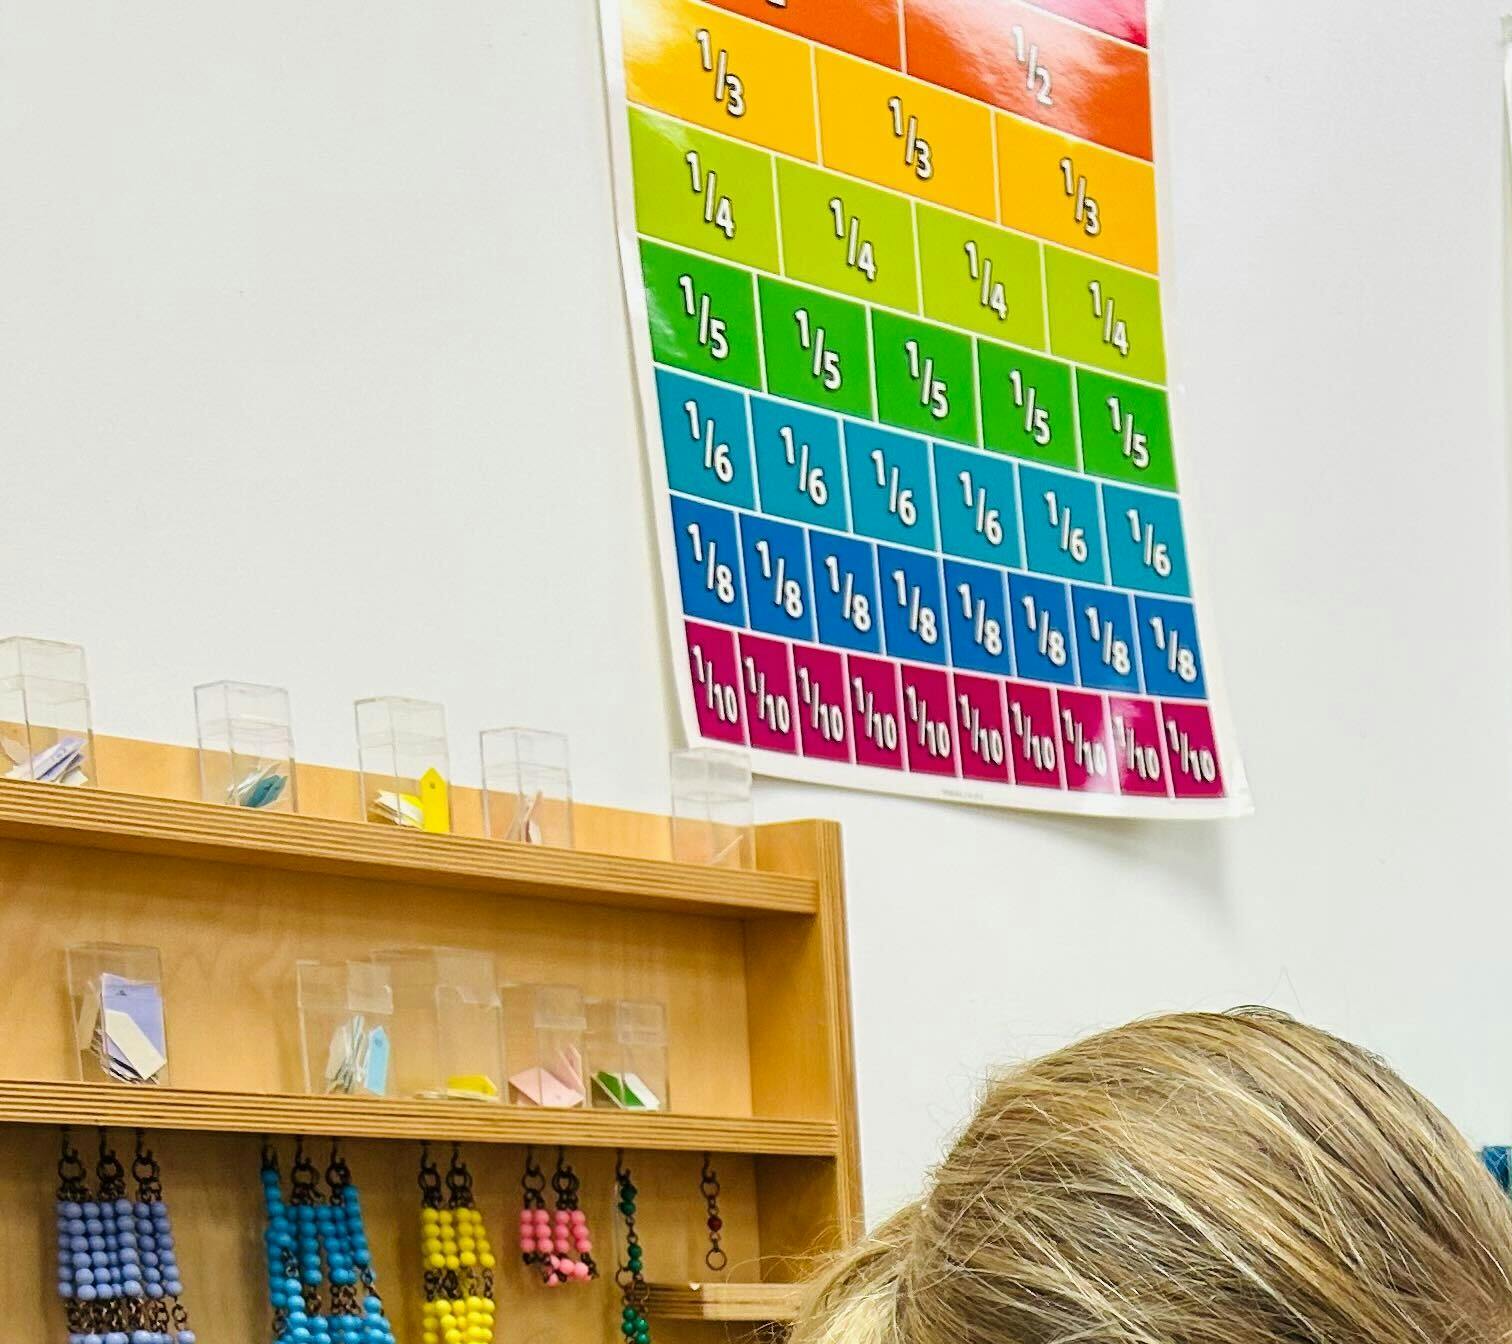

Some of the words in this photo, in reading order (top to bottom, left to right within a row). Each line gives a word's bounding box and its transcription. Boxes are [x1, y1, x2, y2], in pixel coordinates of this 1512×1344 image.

[695, 30, 744, 117] 1/3
[889, 98, 932, 179] 1/3
[1059, 156, 1100, 235] 1/3
[1011, 24, 1054, 106] 1/2
[685, 151, 735, 239] 1/4
[829, 199, 876, 281] 1/4
[964, 242, 1007, 320] 1/4
[1089, 281, 1128, 356] 1/4
[678, 275, 729, 360] 1/5
[793, 309, 842, 391] 1/5
[904, 340, 949, 419] 1/5
[1008, 369, 1051, 446] 1/5
[1106, 396, 1149, 469] 1/5
[684, 400, 734, 484] 1/6
[778, 426, 828, 506] 1/6
[870, 449, 917, 527] 1/6
[958, 471, 1003, 546] 1/6
[1043, 491, 1088, 563] 1/6
[1126, 509, 1172, 578] 1/6
[686, 523, 735, 605] 1/8
[755, 540, 804, 619] 1/8
[824, 555, 872, 633] 1/8
[892, 570, 938, 645] 1/8
[957, 583, 1003, 657] 1/8
[1021, 595, 1067, 667] 1/8
[1084, 607, 1131, 676] 1/8
[1149, 617, 1197, 683] 1/8
[691, 645, 738, 725] 1/10
[743, 656, 790, 735] 1/10
[797, 667, 844, 743] 1/10
[851, 677, 898, 751] 1/10
[904, 685, 951, 759] 1/10
[957, 694, 1004, 766] 1/10
[1009, 702, 1056, 772] 1/10
[1062, 709, 1107, 776] 1/10
[1113, 715, 1161, 782] 1/10
[1164, 720, 1216, 783] 1/10
